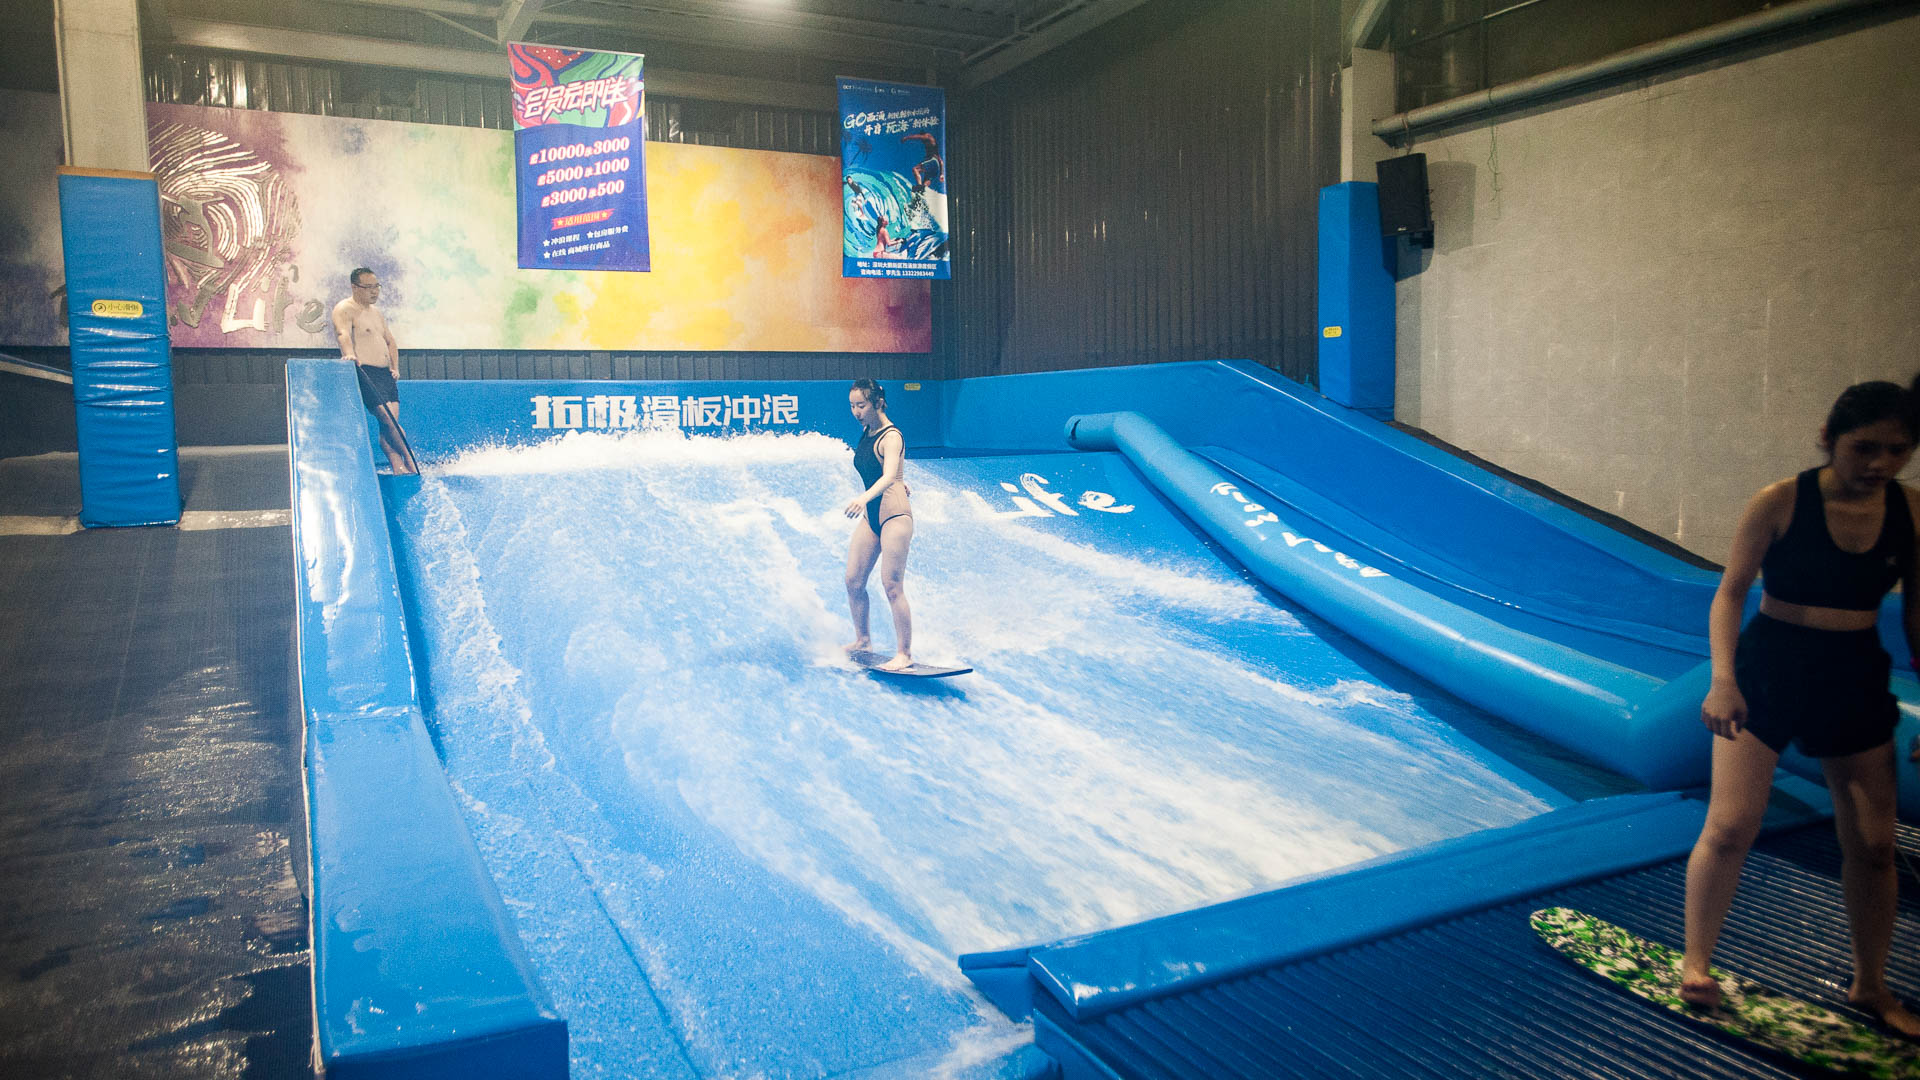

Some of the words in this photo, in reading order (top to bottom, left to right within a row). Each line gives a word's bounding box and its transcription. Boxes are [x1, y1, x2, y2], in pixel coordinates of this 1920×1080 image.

[530, 394, 800, 429] 拓极滑板冲浪
